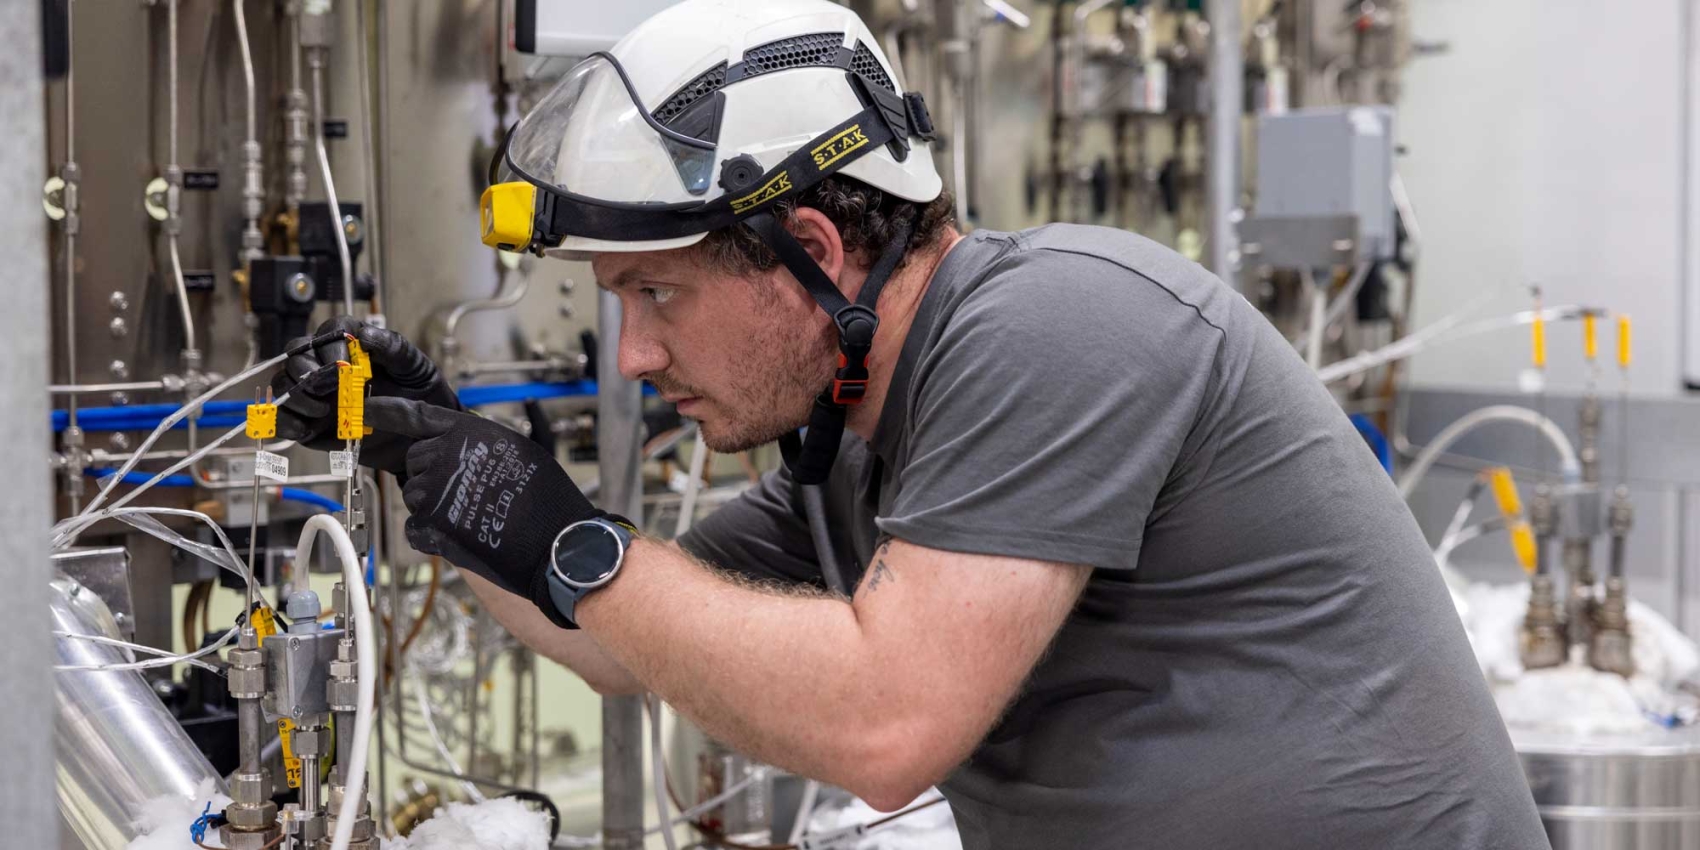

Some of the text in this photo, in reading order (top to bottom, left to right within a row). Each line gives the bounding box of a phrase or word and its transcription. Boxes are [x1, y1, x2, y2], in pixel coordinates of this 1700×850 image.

[464, 458, 497, 530] PULSE PU6
[515, 462, 538, 495] 3121X
[478, 514, 492, 543] CAT
